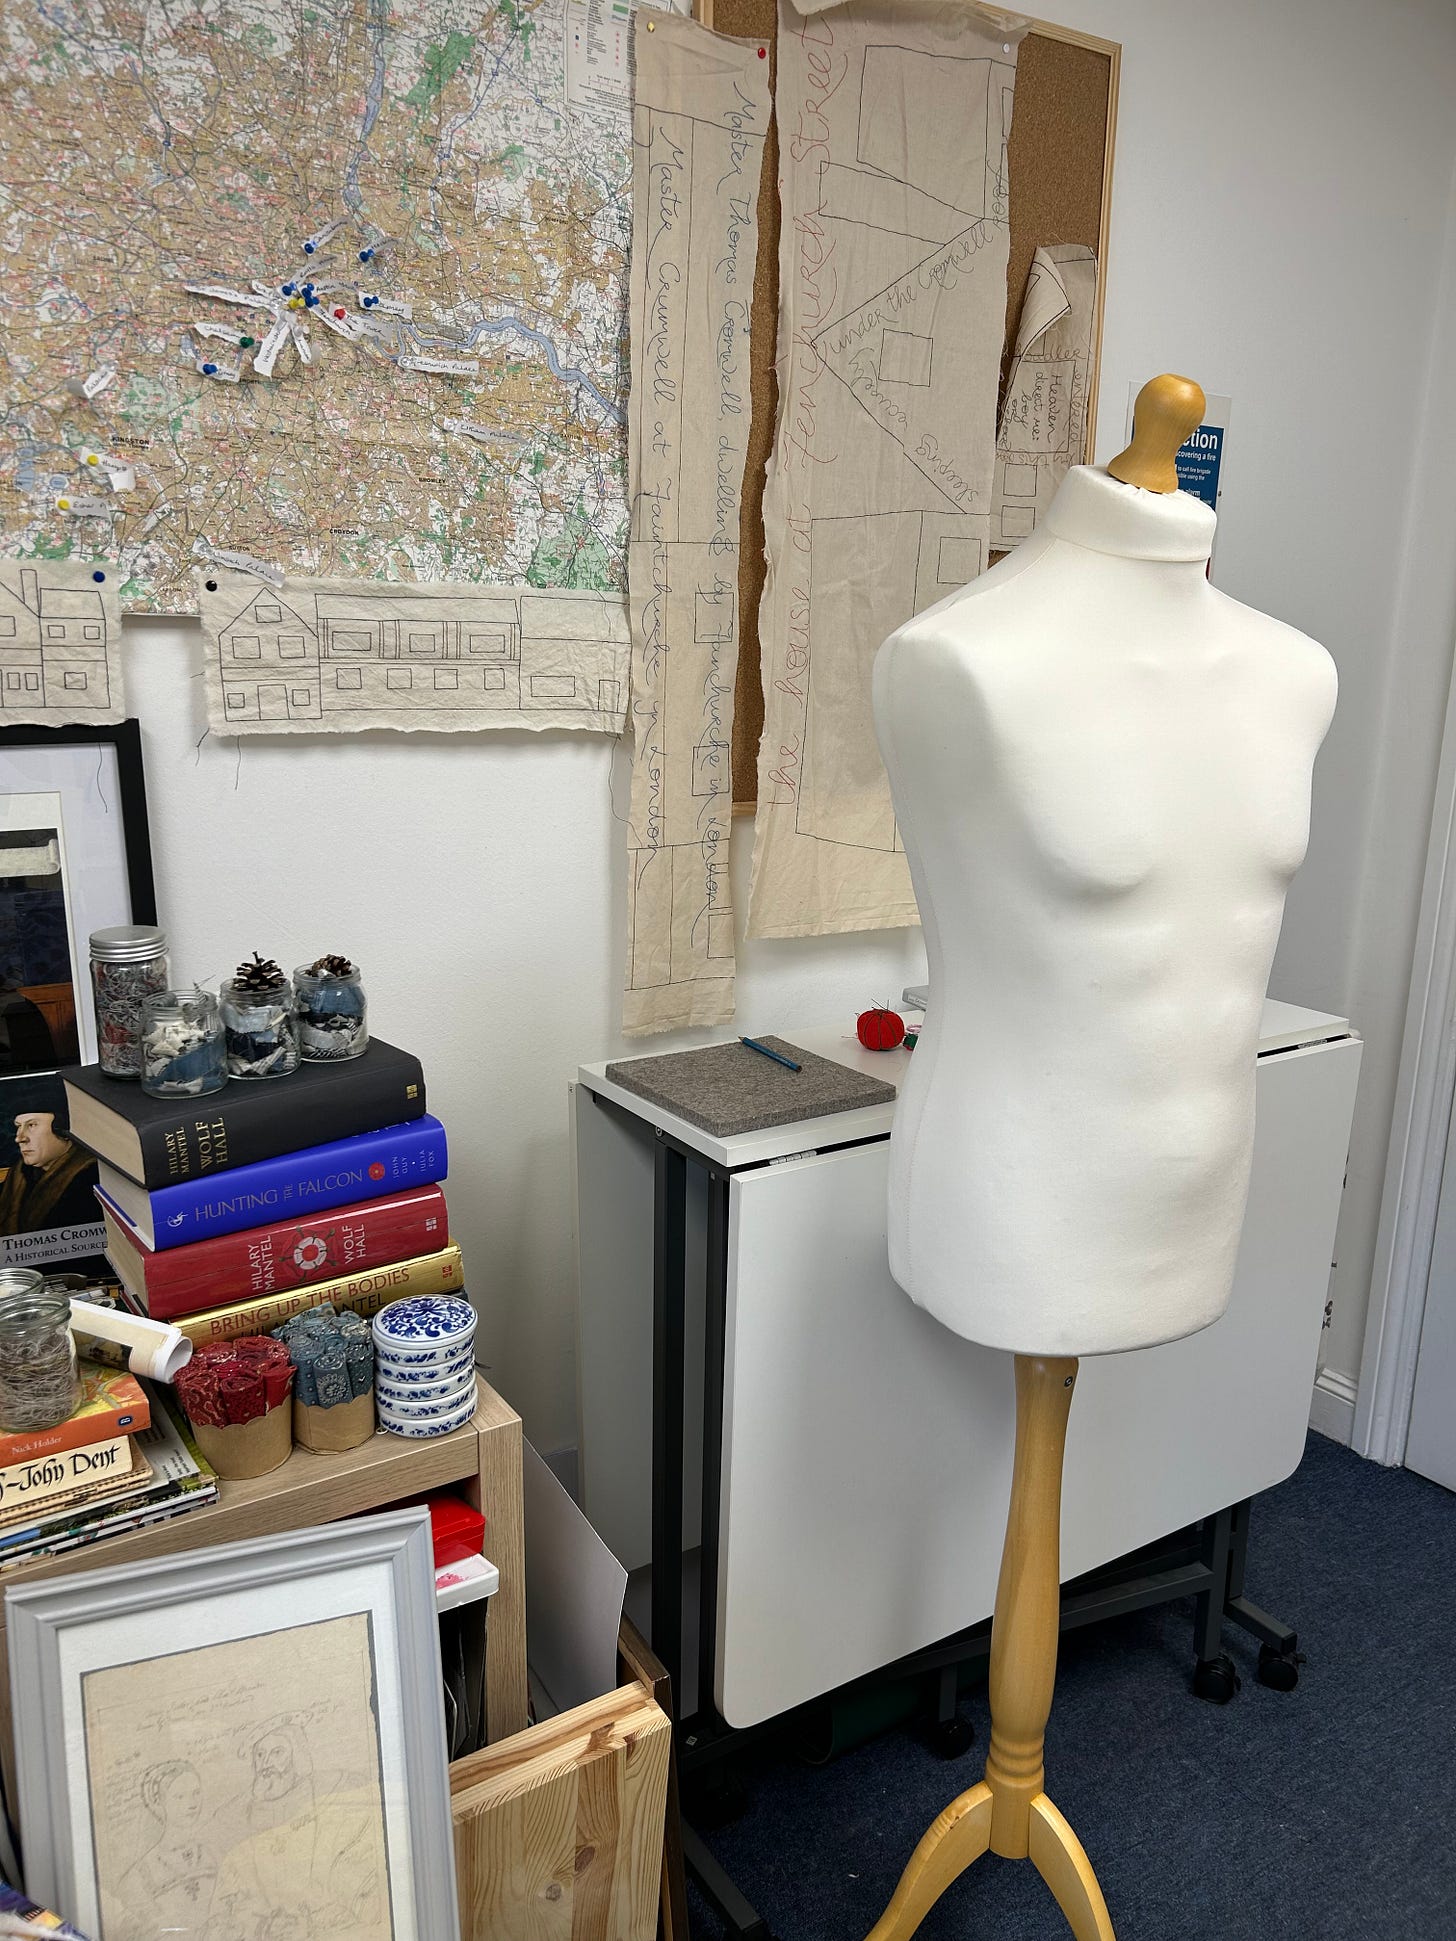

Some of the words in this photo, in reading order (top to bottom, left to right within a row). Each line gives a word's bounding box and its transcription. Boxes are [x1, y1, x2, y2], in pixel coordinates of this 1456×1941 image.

[790, 16, 848, 174] Street
[716, 82, 756, 195] Master
[715, 192, 751, 284] Thomas
[886, 284, 917, 313] the
[647, 262, 680, 405] Crumwell
[784, 200, 838, 473] Fenchurch
[830, 308, 900, 354] under
[1014, 391, 1031, 430] boy
[1031, 372, 1047, 412] direct
[1047, 375, 1064, 443] Heaven
[112, 436, 150, 445] KINGSTON
[654, 421, 673, 458] at
[1177, 450, 1202, 461] covering
[1206, 452, 1217, 461] fire
[418, 476, 446, 484] BROMLEY
[915, 433, 979, 502] sleeping
[709, 436, 739, 557] dwelling
[329, 527, 360, 536] CROYDON
[786, 502, 811, 553] at
[698, 573, 733, 605] by
[774, 579, 810, 710] house
[767, 734, 799, 812] the
[637, 744, 668, 891] London
[697, 778, 720, 830] in
[691, 817, 727, 949] London
[164, 1133, 179, 1175] HILARY
[176, 1126, 190, 1175] MANTEL
[195, 1121, 214, 1170] WOLF
[212, 1117, 228, 1164] HALL
[195, 1189, 278, 1221] HUNTING
[283, 1184, 293, 1201] THE
[298, 1169, 364, 1197] FALCON
[3, 1233, 57, 1251] THOMAS
[5, 1255, 13, 1264] A
[15, 1247, 70, 1262] HISTORICAL
[260, 1235, 276, 1290] MANTEL
[341, 1225, 355, 1264] WOLF
[354, 1224, 367, 1258] HALL
[247, 1244, 263, 1290] HILARY
[210, 1306, 270, 1336] BRING
[276, 1298, 300, 1317] UP
[306, 1286, 342, 1309] THE
[347, 1268, 411, 1297] BODIES
[333, 1293, 386, 1317] NTEL
[11, 1443, 33, 1456] Nick
[33, 1436, 63, 1449] Holder
[68, 1445, 121, 1477] Dent
